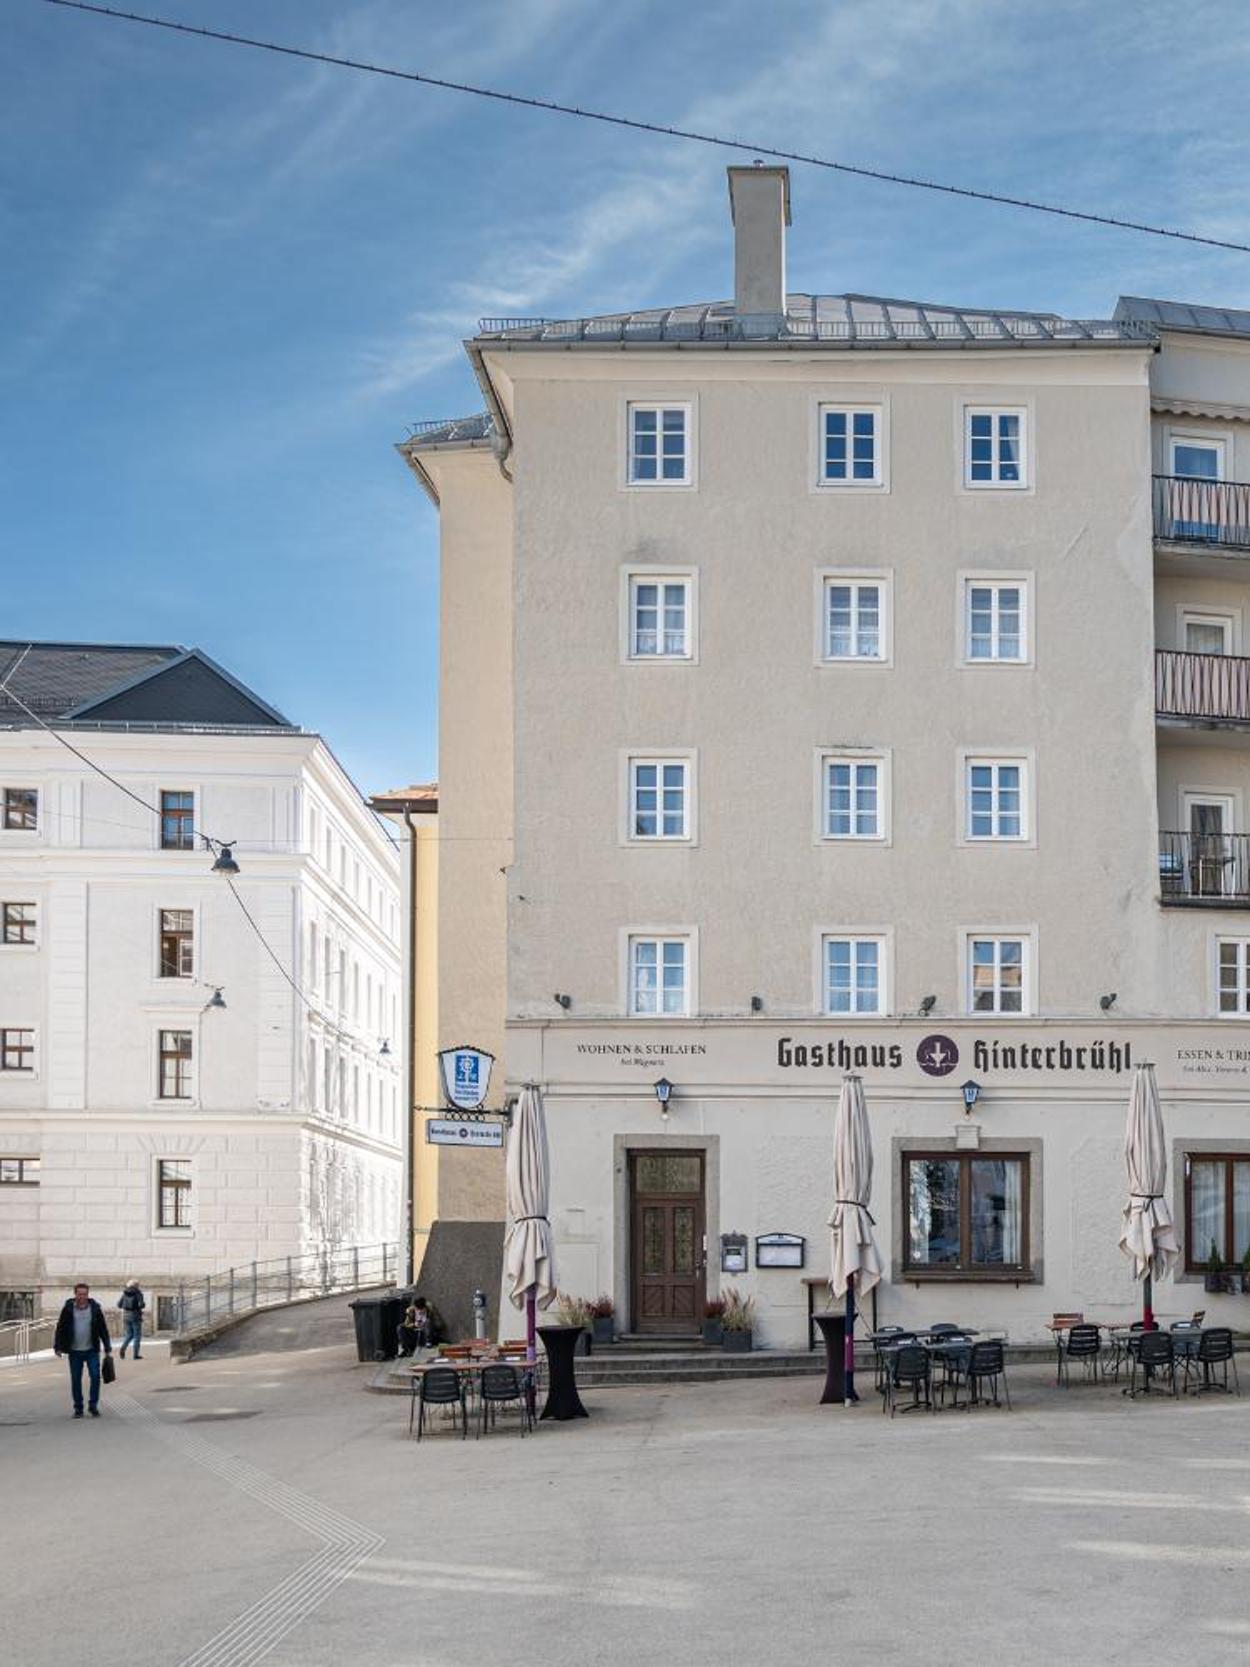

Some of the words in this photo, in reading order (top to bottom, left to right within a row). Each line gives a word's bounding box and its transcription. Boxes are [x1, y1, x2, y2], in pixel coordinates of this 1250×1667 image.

[577, 1044, 632, 1055] WOHNEN
[634, 1044, 643, 1055] &
[645, 1044, 706, 1055] SCHLAFEN
[777, 1037, 902, 1071] Gasthaus
[973, 1039, 1132, 1073] Hinterbrühl
[1177, 1049, 1213, 1060] ESSEN
[1215, 1049, 1225, 1060] &
